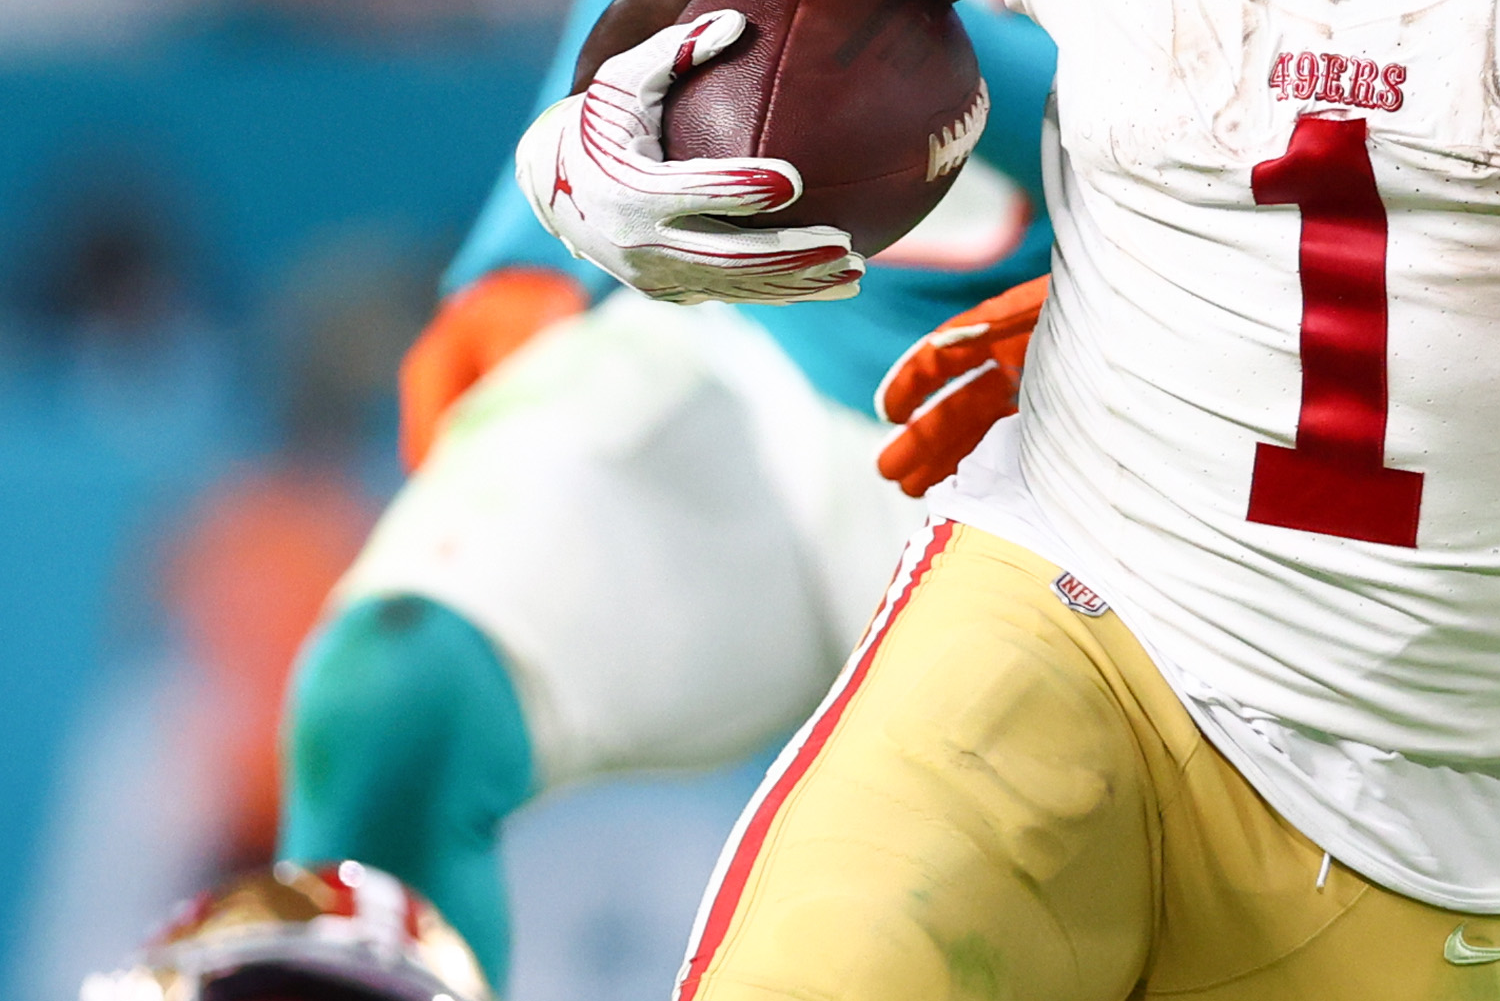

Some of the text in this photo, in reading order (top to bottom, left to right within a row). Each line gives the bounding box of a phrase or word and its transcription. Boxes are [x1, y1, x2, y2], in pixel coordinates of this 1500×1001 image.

[1268, 51, 1407, 113] 49ERS
[1246, 116, 1424, 548] 1
[1060, 575, 1099, 608] NFL
